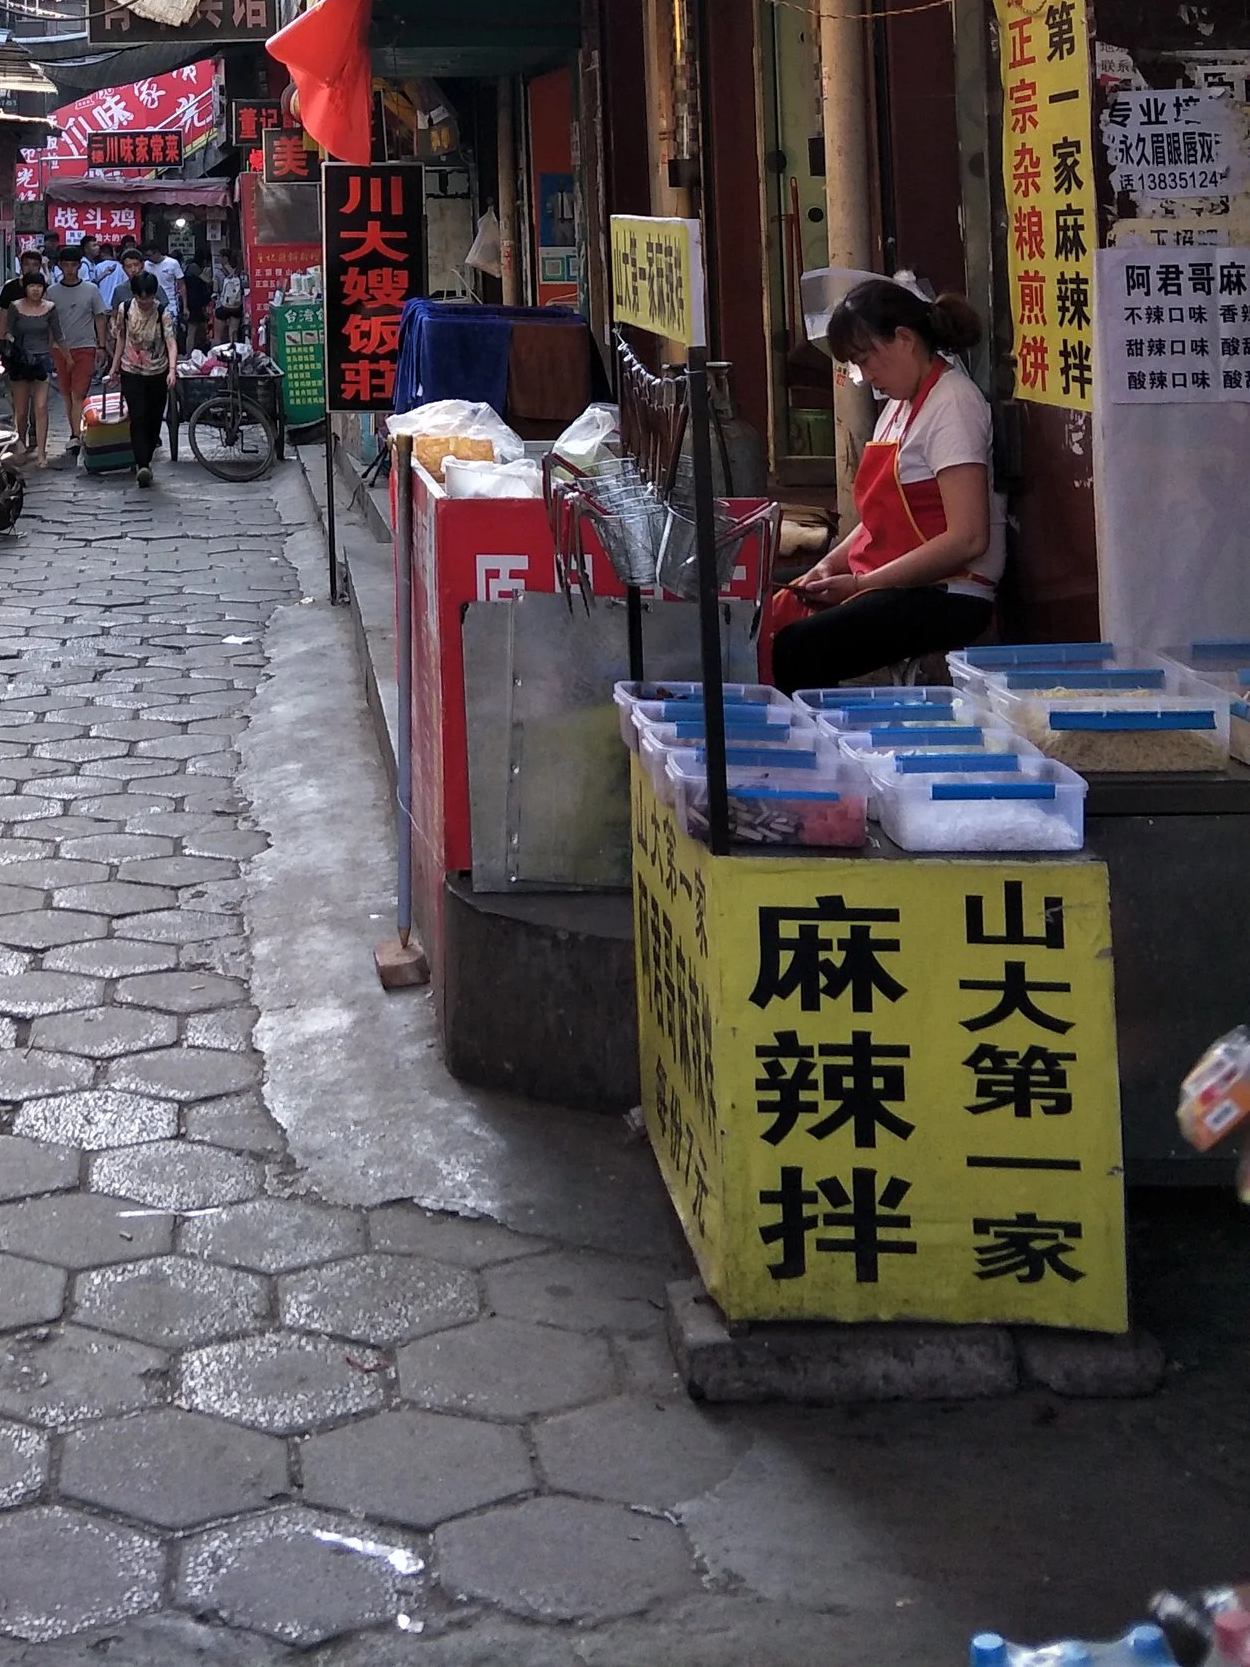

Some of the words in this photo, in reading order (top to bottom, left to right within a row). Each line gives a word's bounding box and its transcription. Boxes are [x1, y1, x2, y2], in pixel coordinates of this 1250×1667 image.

[54, 206, 137, 231] 战斗鸡
[1124, 304, 1208, 325] 不辣口味
[1126, 337, 1210, 358] 甜辣口味
[1127, 369, 1211, 391] 酸辣口味
[748, 895, 918, 1284] 麻辣拌
[957, 880, 1087, 1284] 山大第一家
